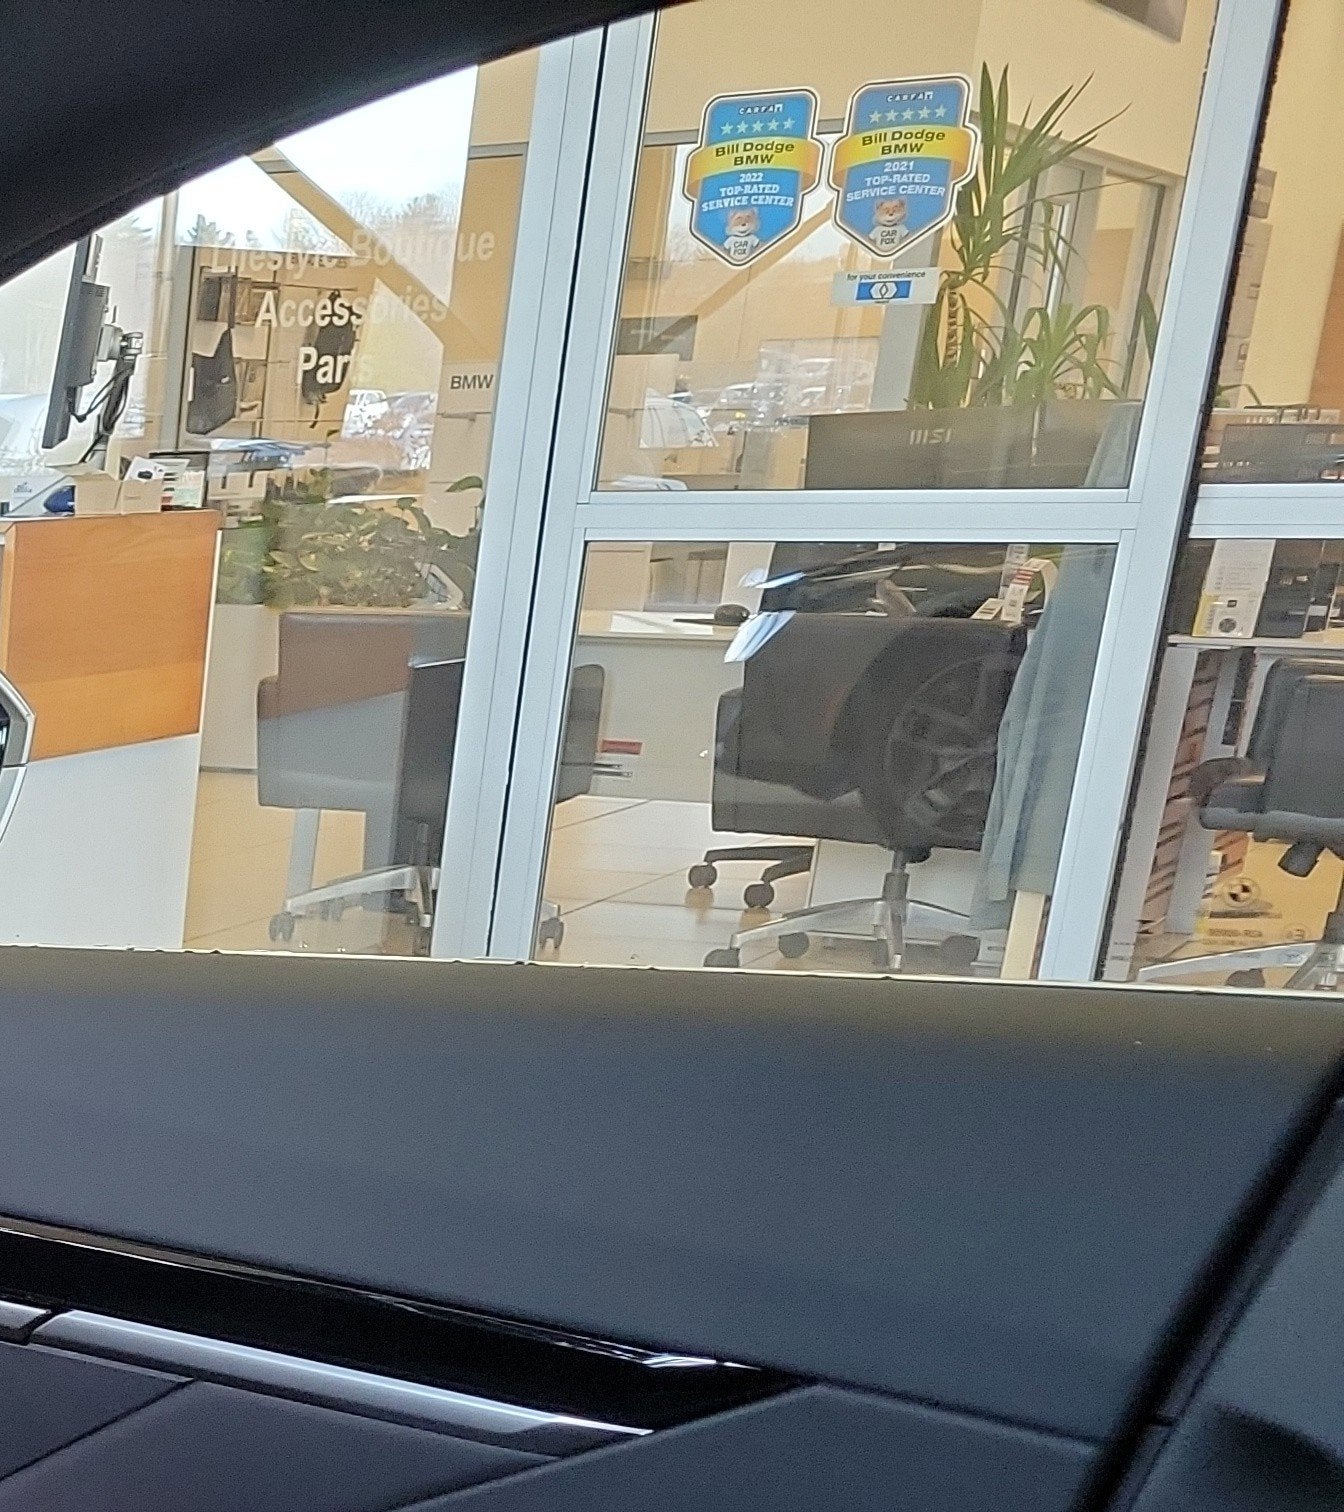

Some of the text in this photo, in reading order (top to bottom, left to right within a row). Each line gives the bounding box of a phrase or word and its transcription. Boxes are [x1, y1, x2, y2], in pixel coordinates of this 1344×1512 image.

[861, 129, 946, 147] Bill Dodge
[715, 140, 795, 157] Bill Dodge
[880, 142, 925, 156] BMW
[733, 153, 775, 167] BMW
[883, 161, 915, 172] 2021
[739, 172, 764, 183] 2022
[865, 173, 931, 187] TOP-RATED
[719, 184, 780, 197] TOP-RATED
[846, 184, 946, 202] SERVICE CENTER
[701, 195, 795, 212] SERVICE CENTER
[880, 229, 898, 238] CAR
[733, 240, 749, 249] CAR
[880, 237, 896, 246] FOX
[846, 270, 927, 282] for your convenience
[449, 374, 494, 391] BMW
